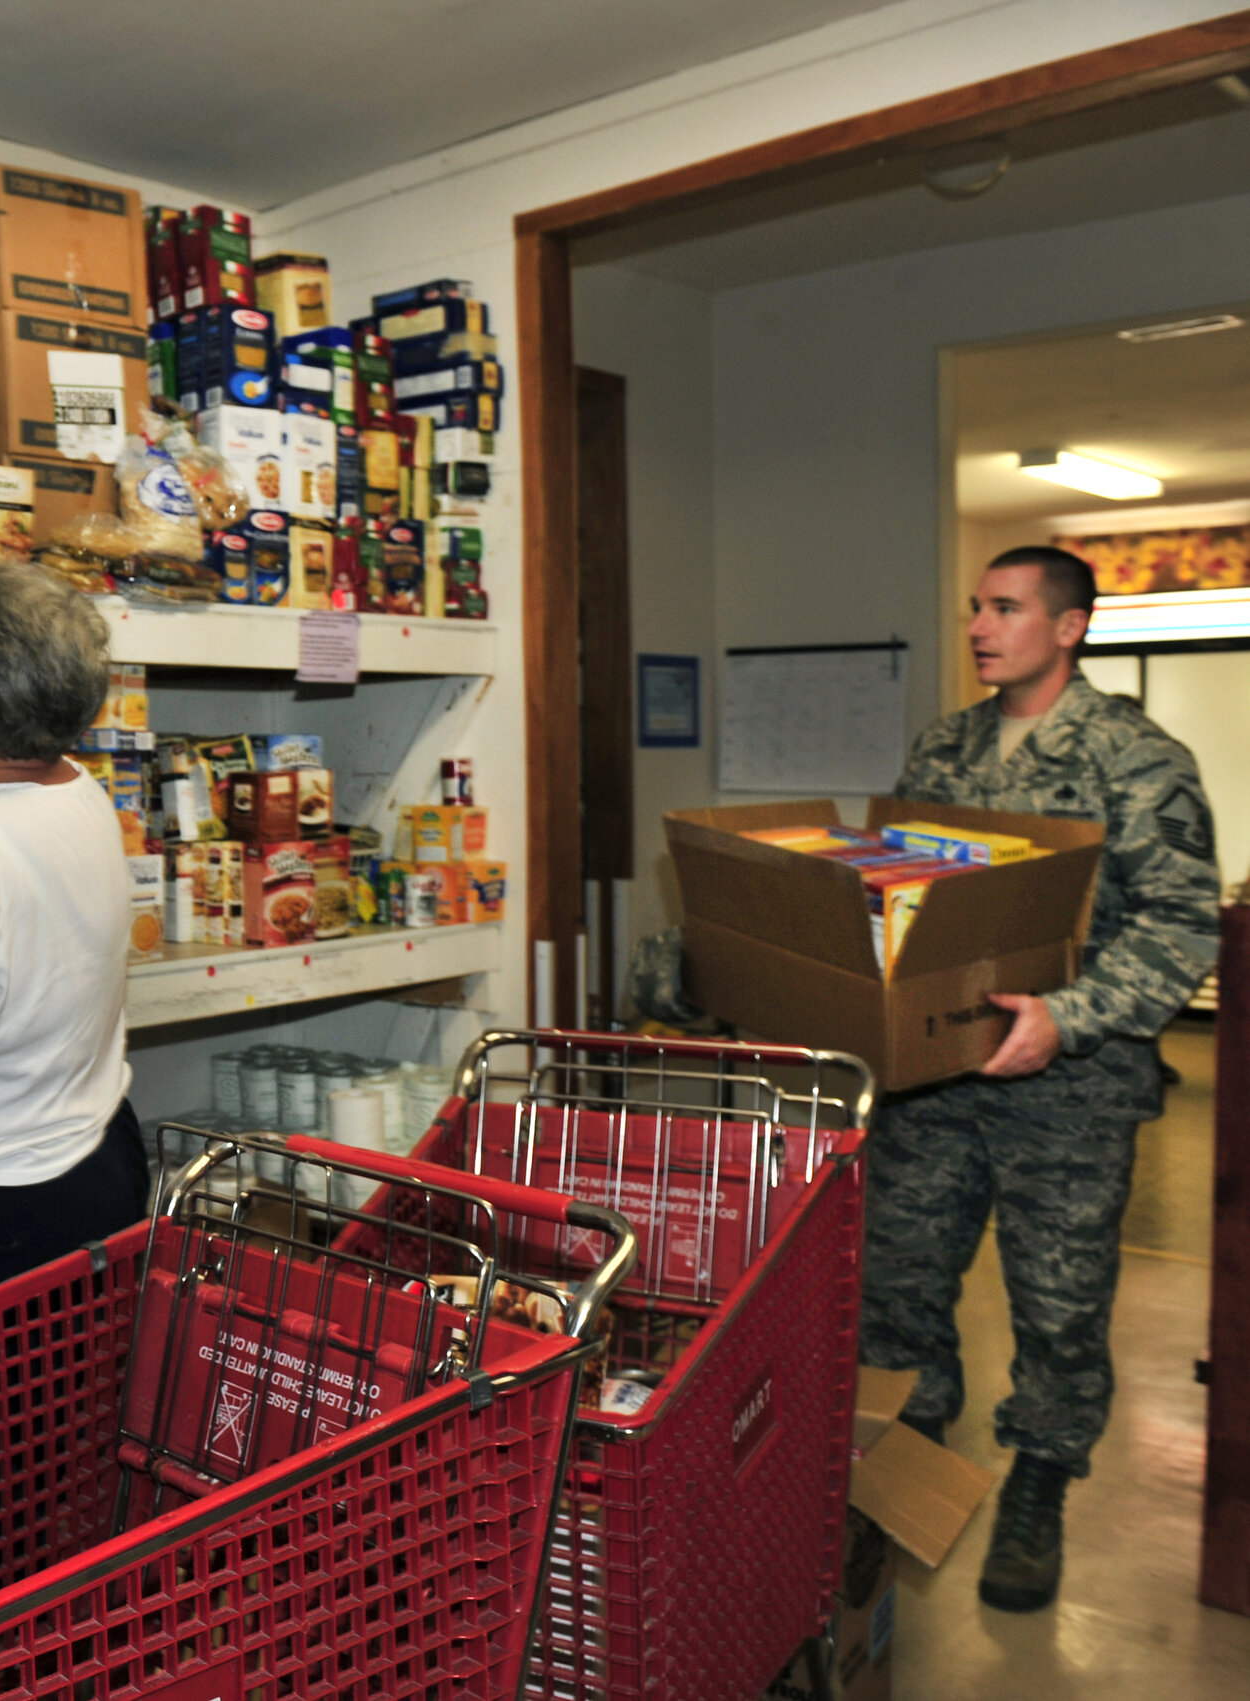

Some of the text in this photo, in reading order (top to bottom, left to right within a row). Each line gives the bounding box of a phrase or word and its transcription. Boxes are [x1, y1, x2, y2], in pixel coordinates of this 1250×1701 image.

[246, 1340, 259, 1357] IN
[270, 1372, 304, 1394] CHILD
[317, 1366, 359, 1390] PERMIT
[306, 1385, 344, 1410] LEAVE
